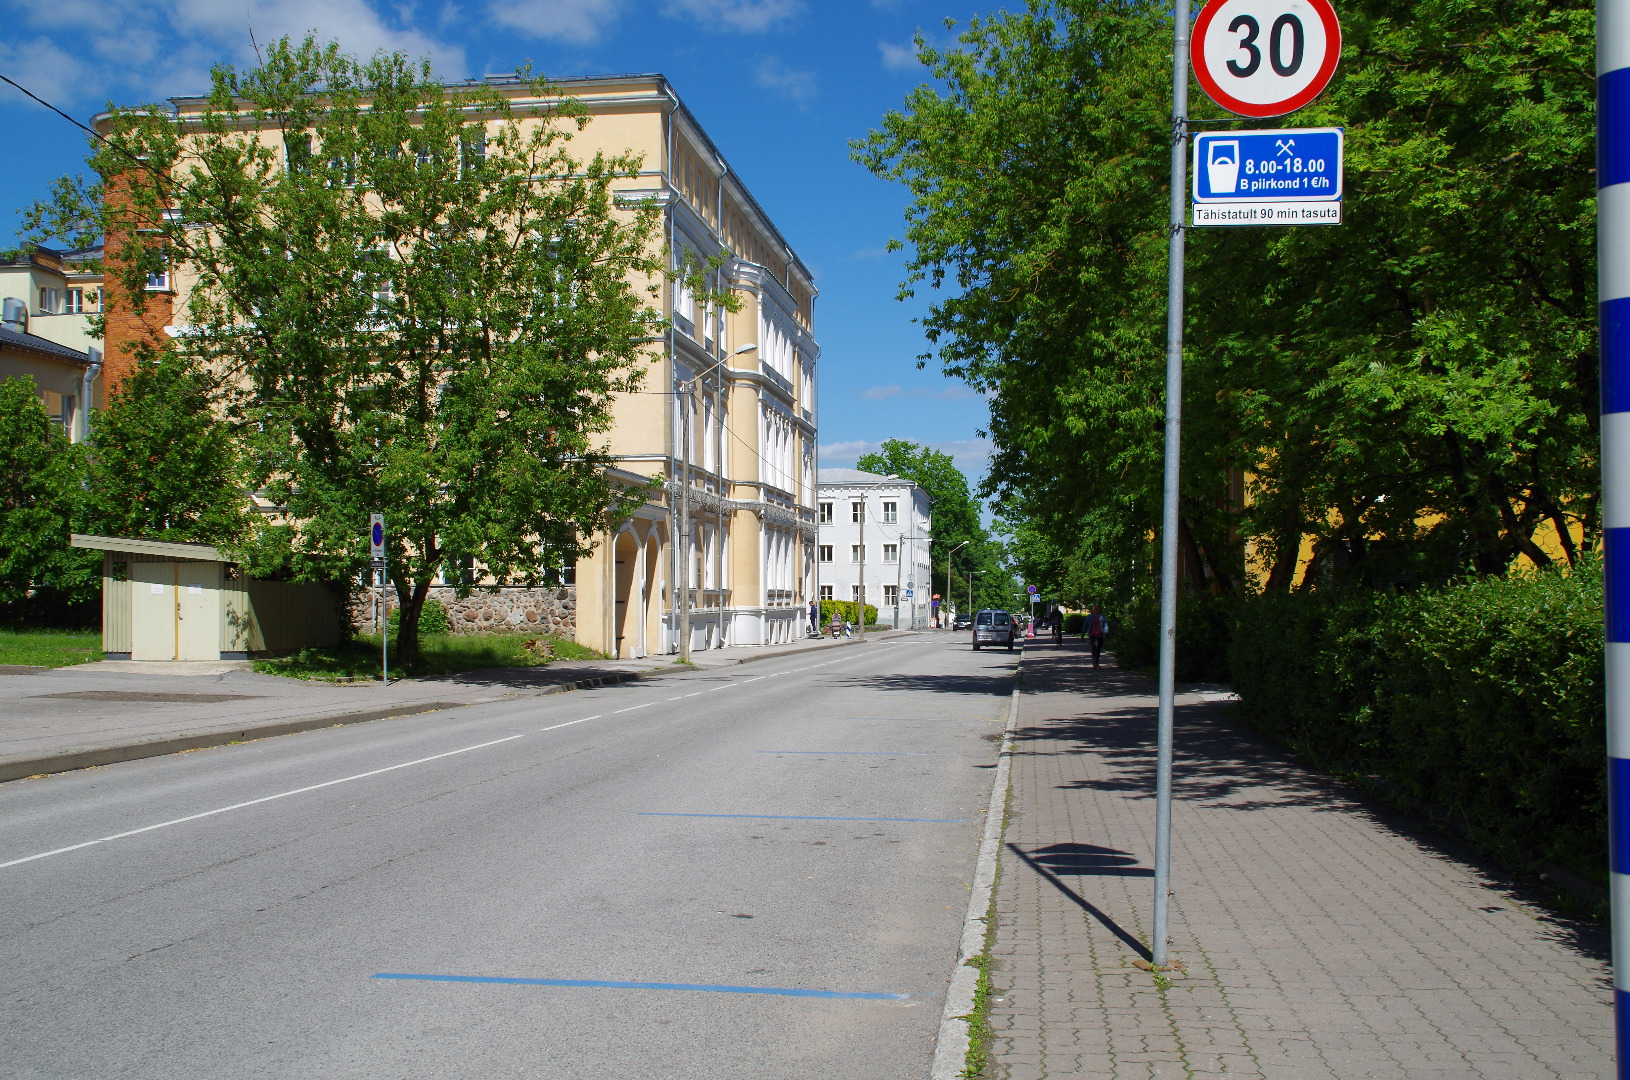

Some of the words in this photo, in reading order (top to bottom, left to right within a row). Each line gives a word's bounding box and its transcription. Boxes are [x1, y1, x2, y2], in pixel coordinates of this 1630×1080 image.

[1226, 13, 1304, 78] 30
[1245, 157, 1325, 174] 8.00-18.00
[1240, 179, 1249, 190] B
[1251, 177, 1300, 192] piirkond
[1196, 208, 1257, 220] Tähistatult
[1260, 209, 1274, 219] 90
[1277, 208, 1298, 219] min
[1301, 208, 1337, 218] tasuta
